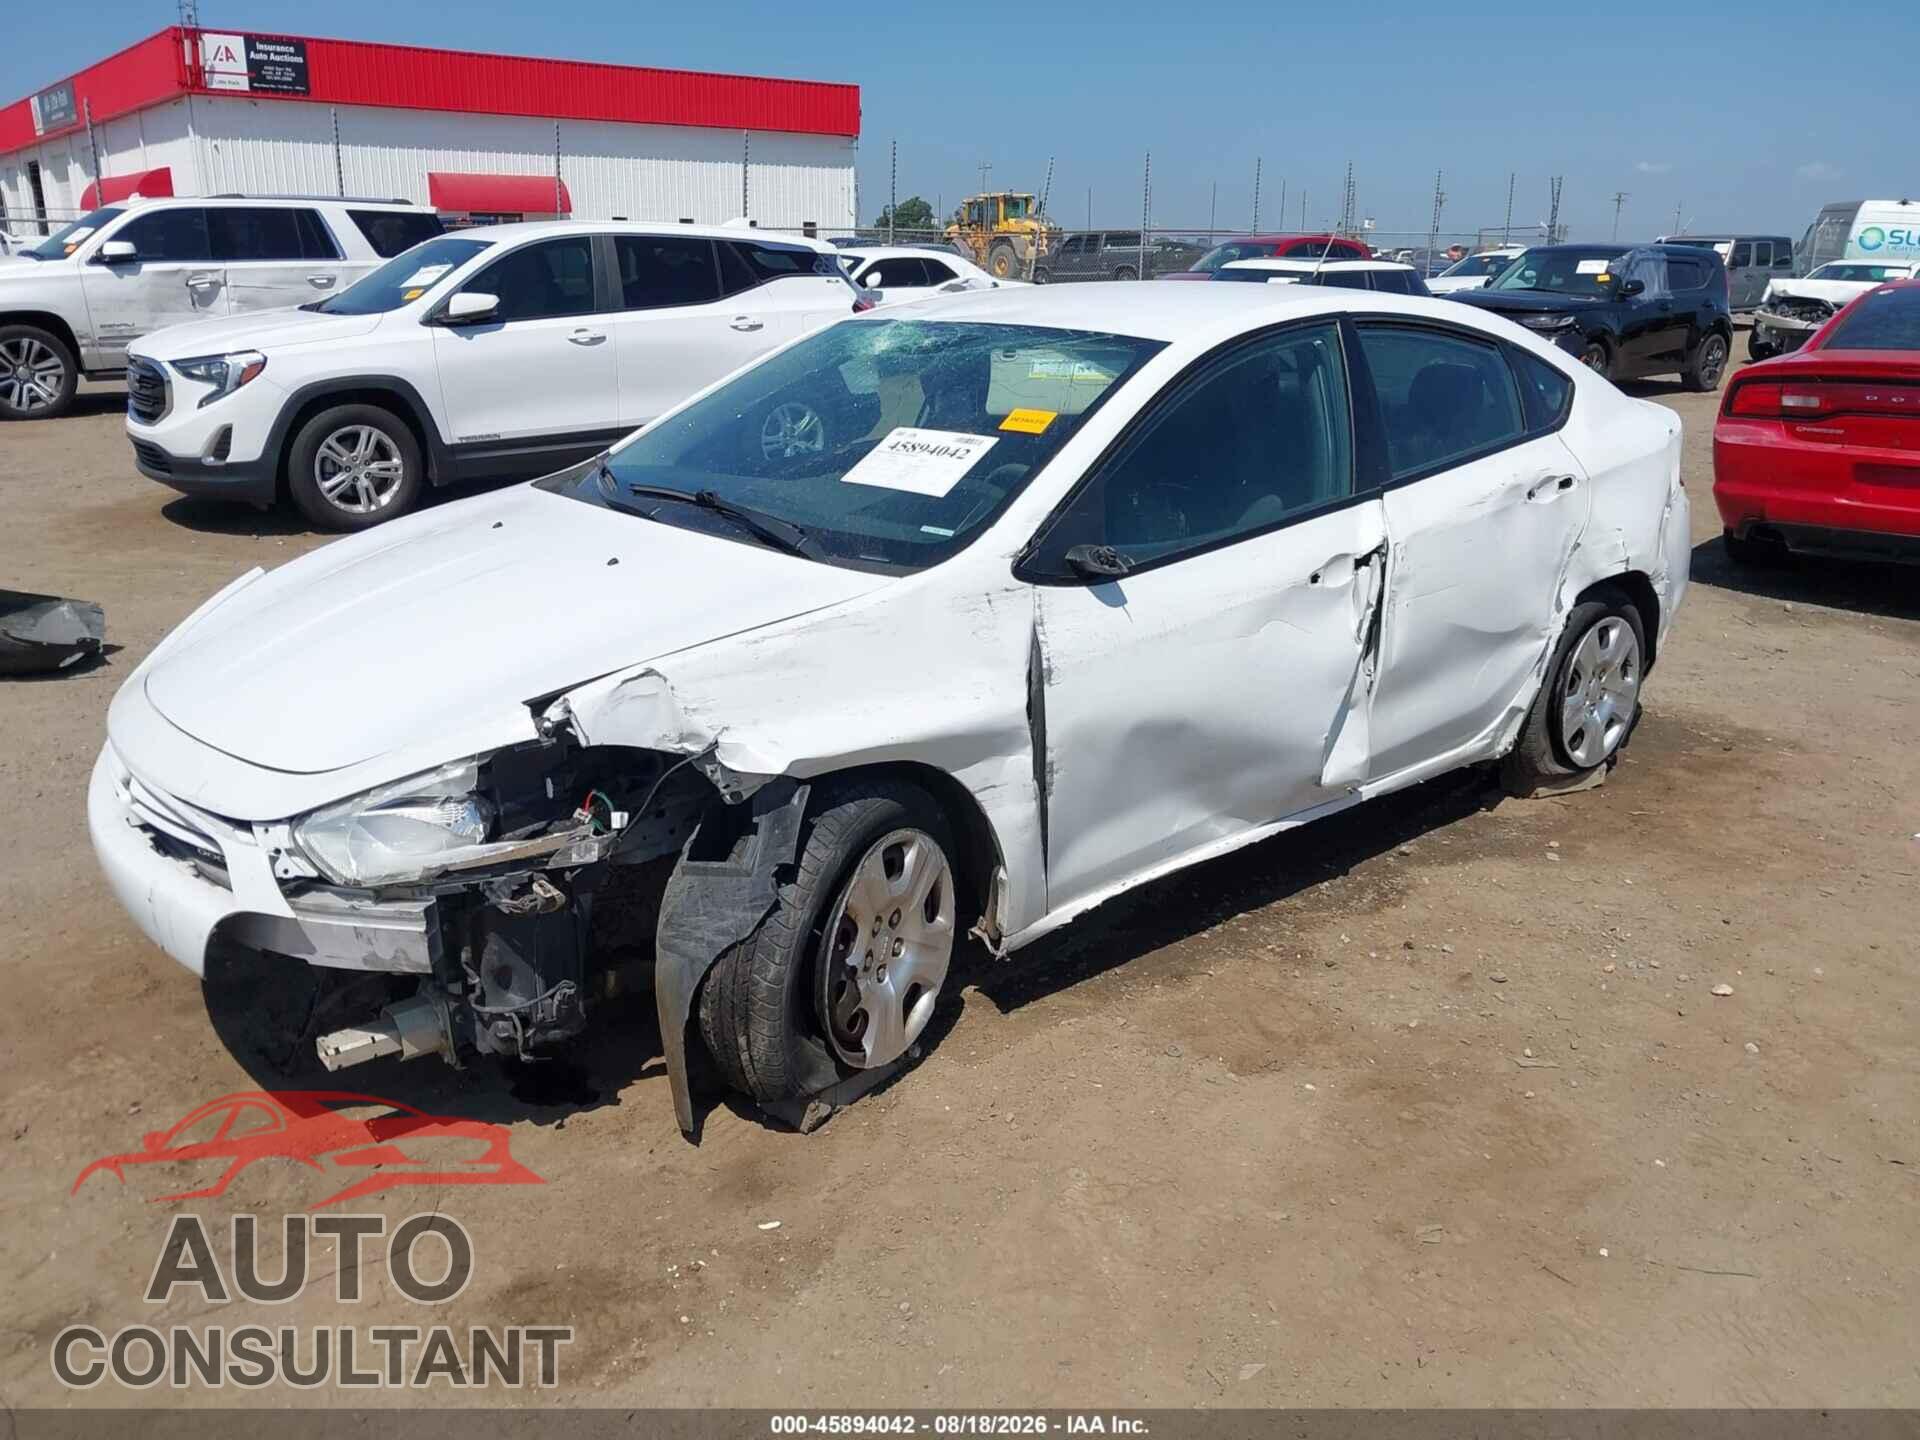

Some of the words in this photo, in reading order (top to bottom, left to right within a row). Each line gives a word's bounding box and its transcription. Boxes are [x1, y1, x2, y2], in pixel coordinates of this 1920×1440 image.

[255, 42, 295, 53] Insurance
[249, 51, 268, 60] Auto
[269, 52, 304, 64] Auctions
[1888, 230, 1920, 246] SL
[888, 440, 971, 460] 45894042
